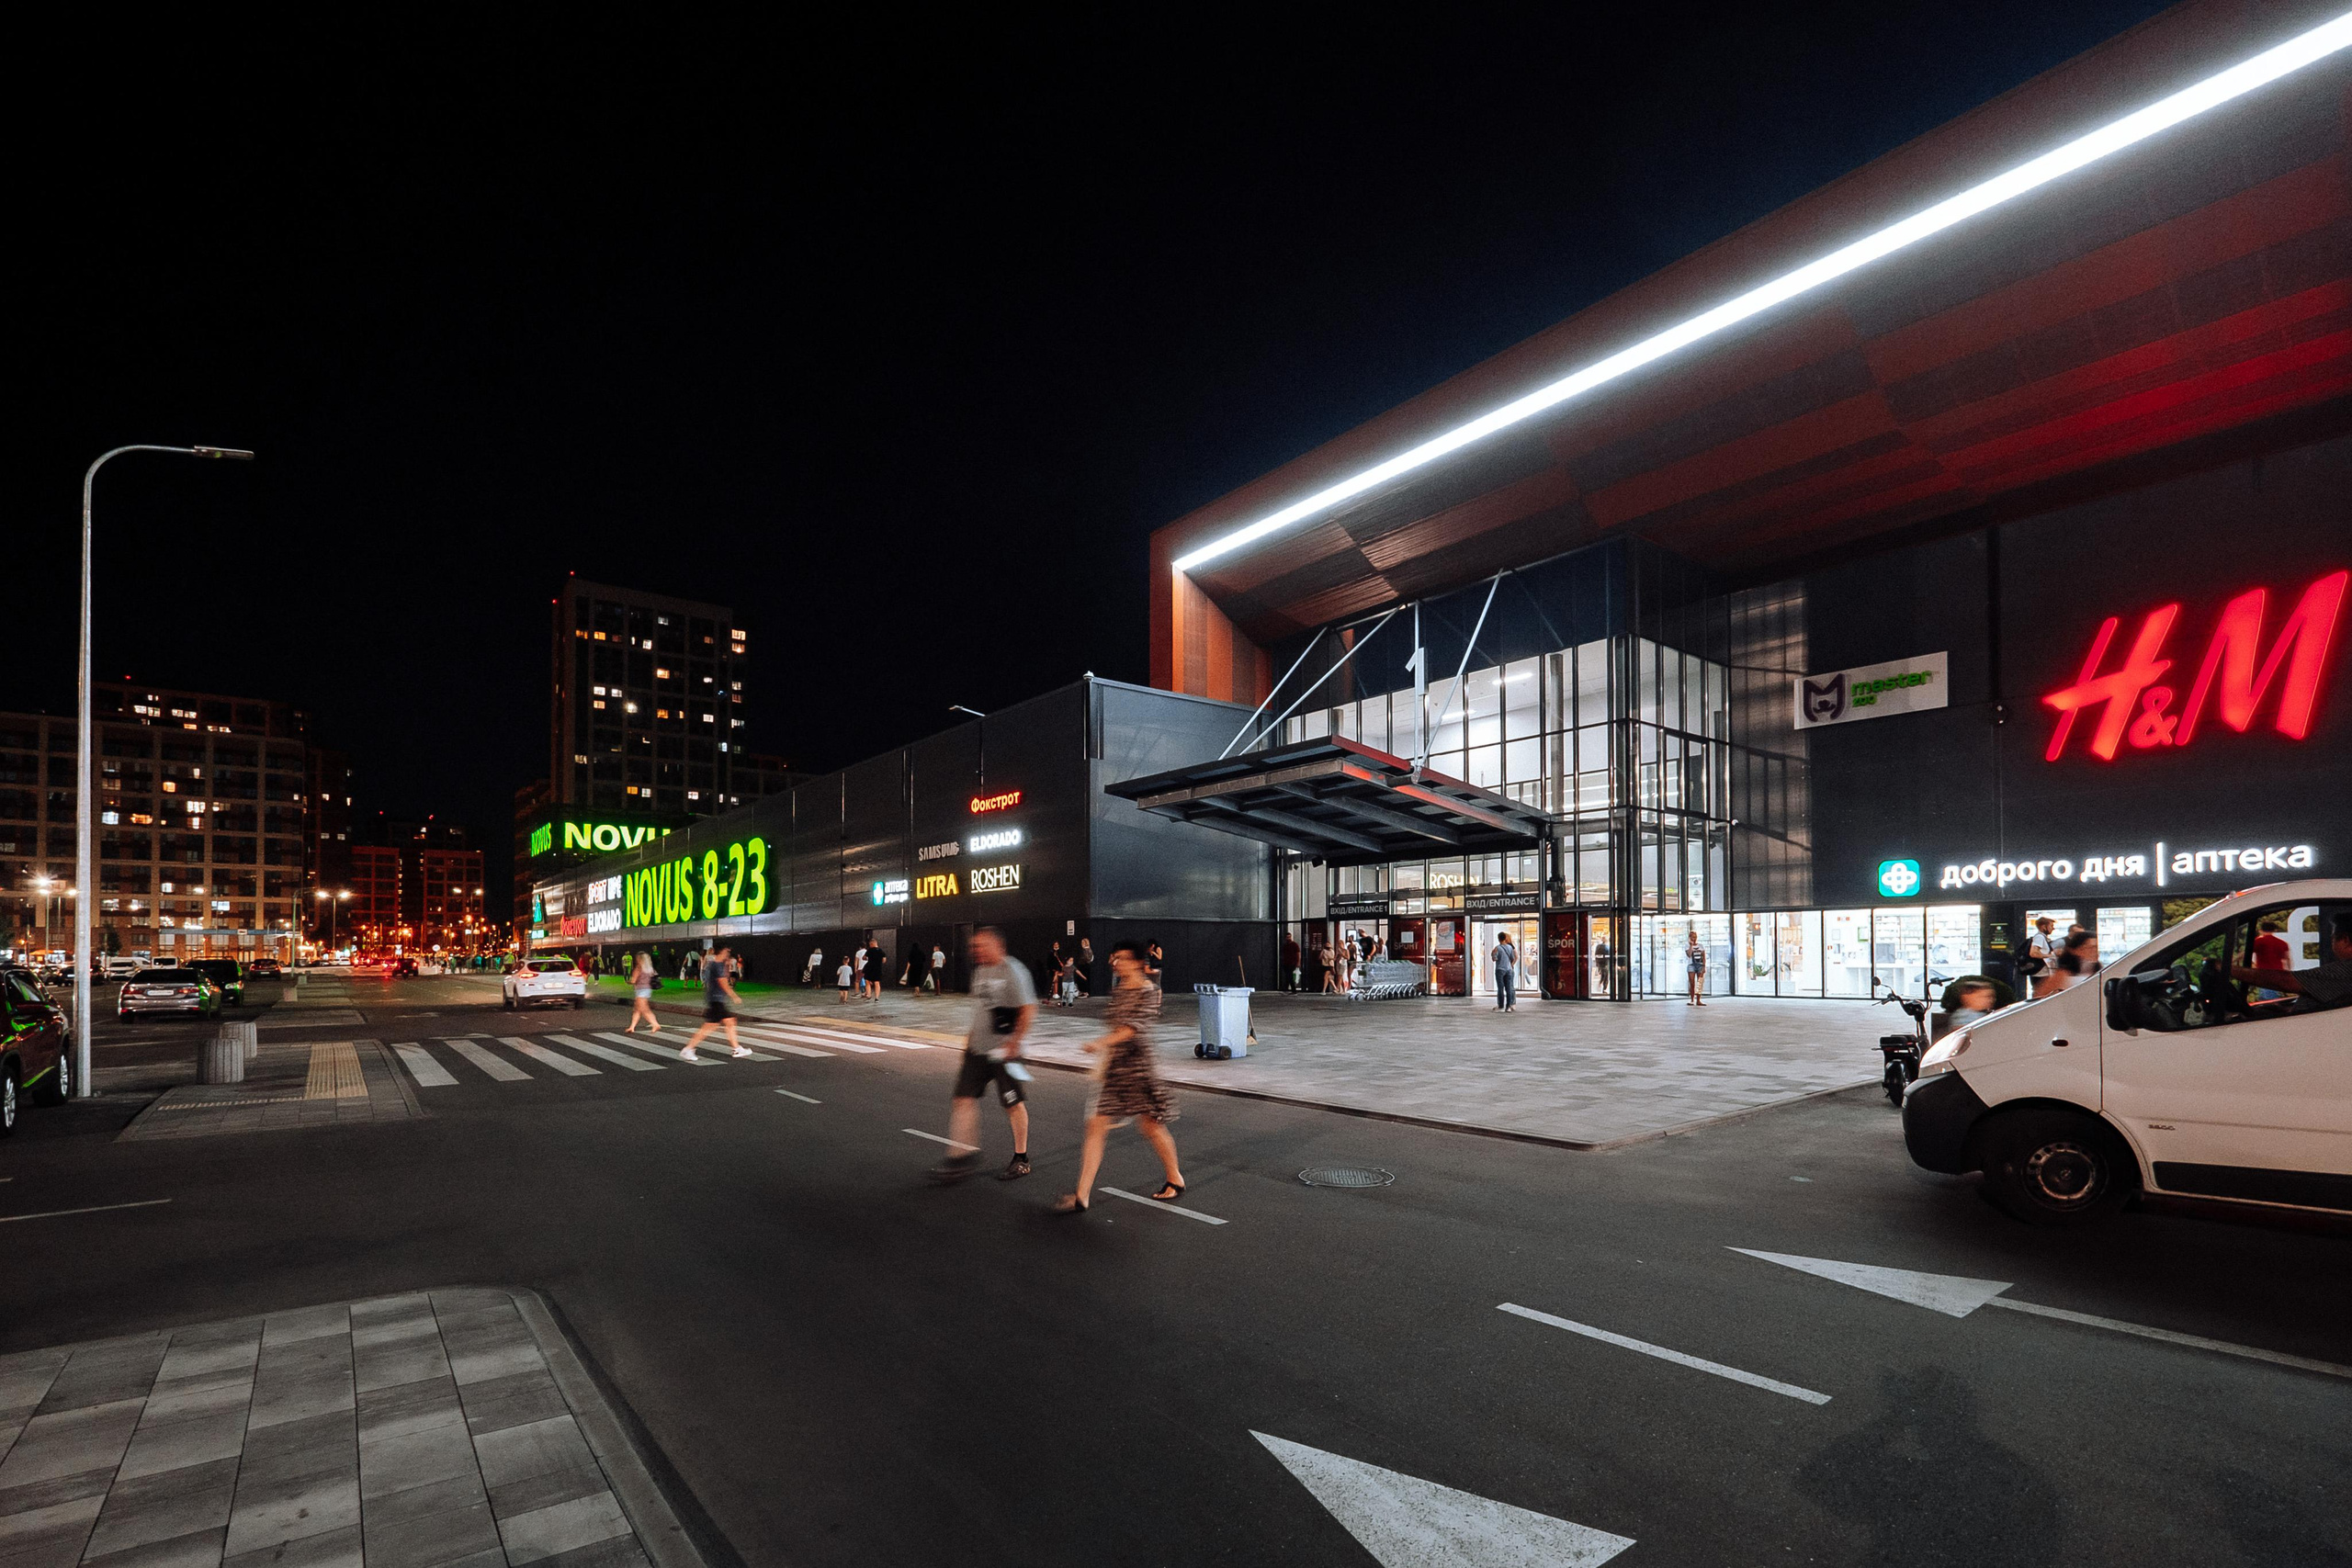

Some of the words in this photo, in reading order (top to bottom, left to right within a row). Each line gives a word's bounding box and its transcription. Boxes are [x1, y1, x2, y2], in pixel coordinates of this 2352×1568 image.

[2042, 570, 2348, 761] H&M
[1851, 671, 1932, 696] master
[1852, 694, 1877, 707] zoo
[970, 792, 1021, 814] Фокстрот
[531, 822, 551, 857] NOVUS
[564, 821, 671, 852] NOV
[970, 829, 1022, 852] ELDORADO
[919, 842, 960, 862] SAMSUNG
[970, 864, 1020, 893] ROSHEN
[1940, 858, 2073, 889] доброго
[2079, 853, 2145, 883] дня
[2171, 844, 2313, 874] аптека
[626, 856, 694, 927] NOVUS
[702, 837, 765, 919] 8-23
[916, 873, 959, 899] LITRA
[1430, 873, 1481, 889] ROSHN
